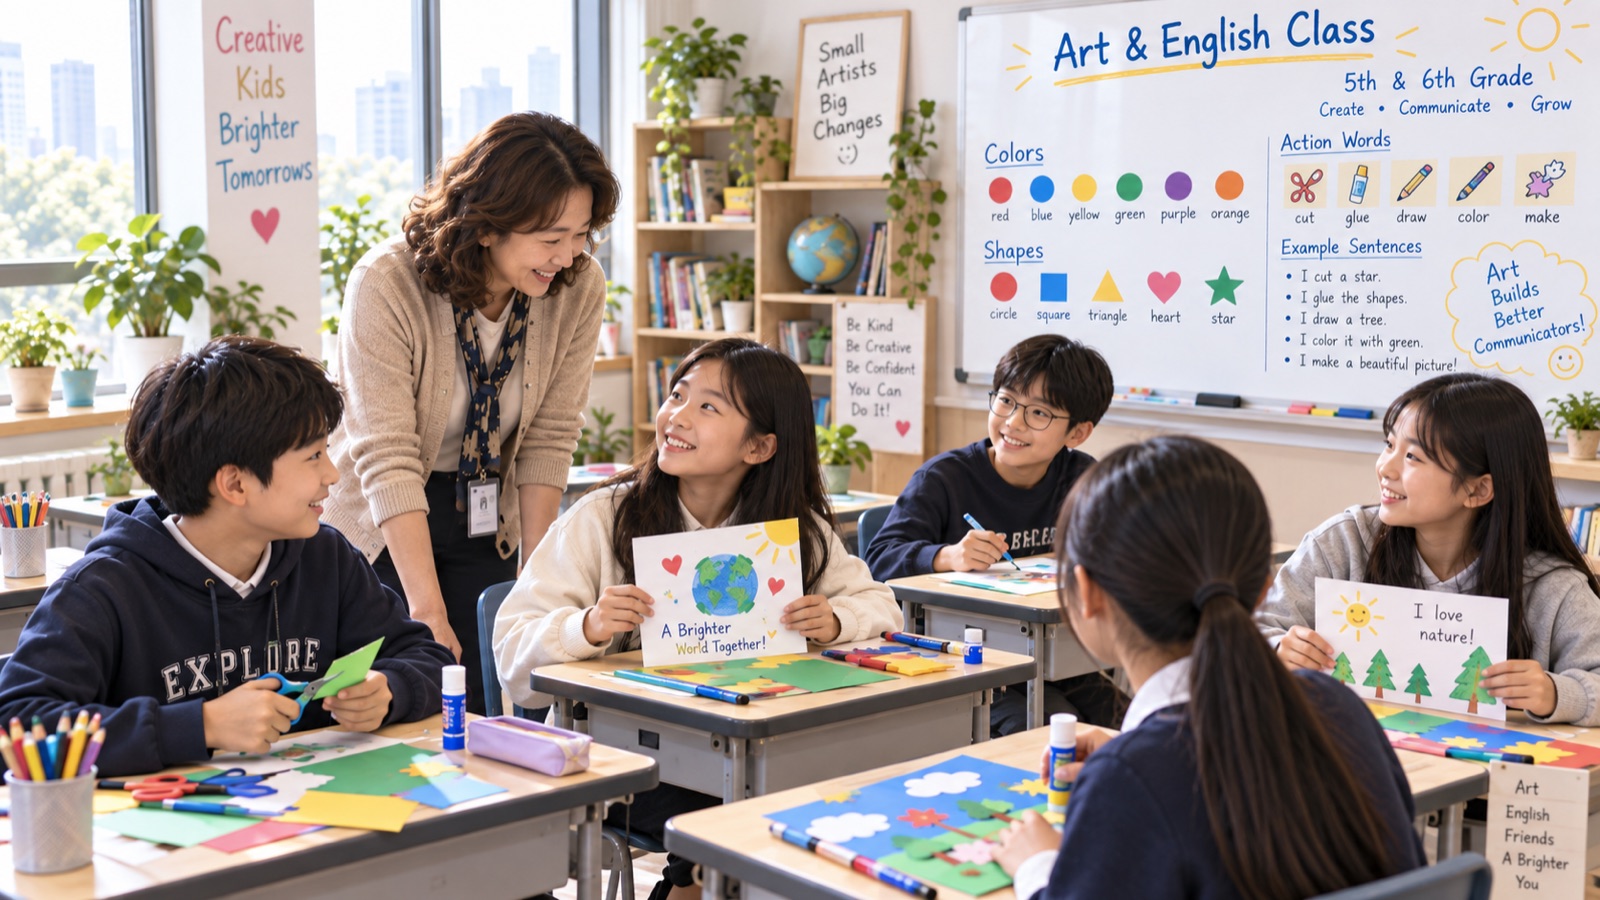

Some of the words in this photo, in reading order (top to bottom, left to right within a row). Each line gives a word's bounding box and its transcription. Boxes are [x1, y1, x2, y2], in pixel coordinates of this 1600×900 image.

[216, 16, 304, 54] Creative
[1054, 31, 1109, 71] Art
[1126, 28, 1148, 61] &
[1162, 16, 1270, 69] English
[1287, 10, 1375, 48] Class
[819, 33, 864, 62] Small
[237, 65, 285, 100] Kids
[817, 60, 877, 89] Artists
[1345, 71, 1377, 92] 5th
[1393, 70, 1406, 90] &
[1422, 68, 1455, 90] 6th
[1470, 66, 1533, 88] Grade
[820, 93, 847, 116] Big
[1320, 101, 1364, 117] Create
[1399, 98, 1490, 116] Communicate
[1532, 95, 1572, 113] Grow
[220, 111, 299, 154] Brighter
[814, 114, 882, 140] Changes
[1281, 134, 1332, 151] Action
[1343, 129, 1391, 149] Words
[985, 141, 1044, 165] Colors
[216, 159, 312, 192] Tomorrows
[991, 208, 1009, 222] red
[1031, 208, 1053, 221] blue
[1069, 207, 1100, 225] yellow
[1115, 210, 1146, 224] green
[1161, 207, 1196, 224] purple
[1211, 208, 1250, 224] orange
[1295, 211, 1315, 224] cut
[1346, 209, 1369, 228] glue
[1397, 209, 1427, 223] draw
[1458, 209, 1489, 223] color
[1525, 209, 1560, 223] make
[985, 240, 1044, 265] Shapes
[1281, 237, 1339, 260] Example
[1349, 237, 1422, 254] Sentences
[1301, 269, 1308, 282] I
[1314, 270, 1332, 282] cut
[1340, 273, 1347, 282] a
[1355, 270, 1381, 283] star.
[1486, 260, 1520, 284] Art
[1301, 291, 1307, 303] I
[1313, 291, 1334, 308] glue
[1341, 291, 1359, 304] the
[1367, 291, 1408, 309] shapes.
[1491, 281, 1540, 306] Builds
[847, 318, 861, 332] Be
[868, 318, 893, 332] Kind
[990, 308, 1017, 320] circle
[1037, 310, 1070, 327] square
[1088, 309, 1128, 326] triangle
[1151, 309, 1181, 323] heart
[1211, 312, 1236, 324] star
[1300, 312, 1307, 325] I
[1313, 312, 1339, 326] draw
[1346, 316, 1352, 326] a
[1359, 313, 1387, 326] tree.
[1494, 305, 1544, 329] Better
[1300, 333, 1307, 346] I
[1312, 334, 1338, 347] color
[1344, 335, 1353, 347] it
[1360, 335, 1383, 348] with
[1389, 337, 1423, 355] green.
[1474, 313, 1586, 354] Communicators!
[846, 339, 860, 352] Be
[866, 339, 912, 353] Creative
[846, 360, 860, 374] Be
[865, 360, 915, 375] Confident
[1299, 354, 1306, 367] I
[1312, 355, 1339, 368] make
[1346, 358, 1353, 369] a
[1360, 354, 1409, 371] beautiful
[1415, 356, 1457, 375] picture!
[849, 382, 870, 397] You
[877, 383, 901, 397] Can
[851, 402, 867, 416] Do
[874, 403, 890, 417] It!
[1414, 603, 1423, 619] I
[1435, 604, 1463, 622] love
[661, 624, 672, 639] A
[678, 621, 731, 640] Brighter
[1420, 629, 1474, 645] nature!
[676, 639, 708, 655] World
[712, 635, 766, 656] Together!
[161, 637, 320, 703] EXPLORE
[1515, 780, 1538, 795] Art
[1506, 805, 1550, 824] English
[1505, 828, 1554, 845] Friends
[1502, 851, 1512, 865] A
[1518, 852, 1569, 872] Brighter
[1516, 875, 1539, 890] You
